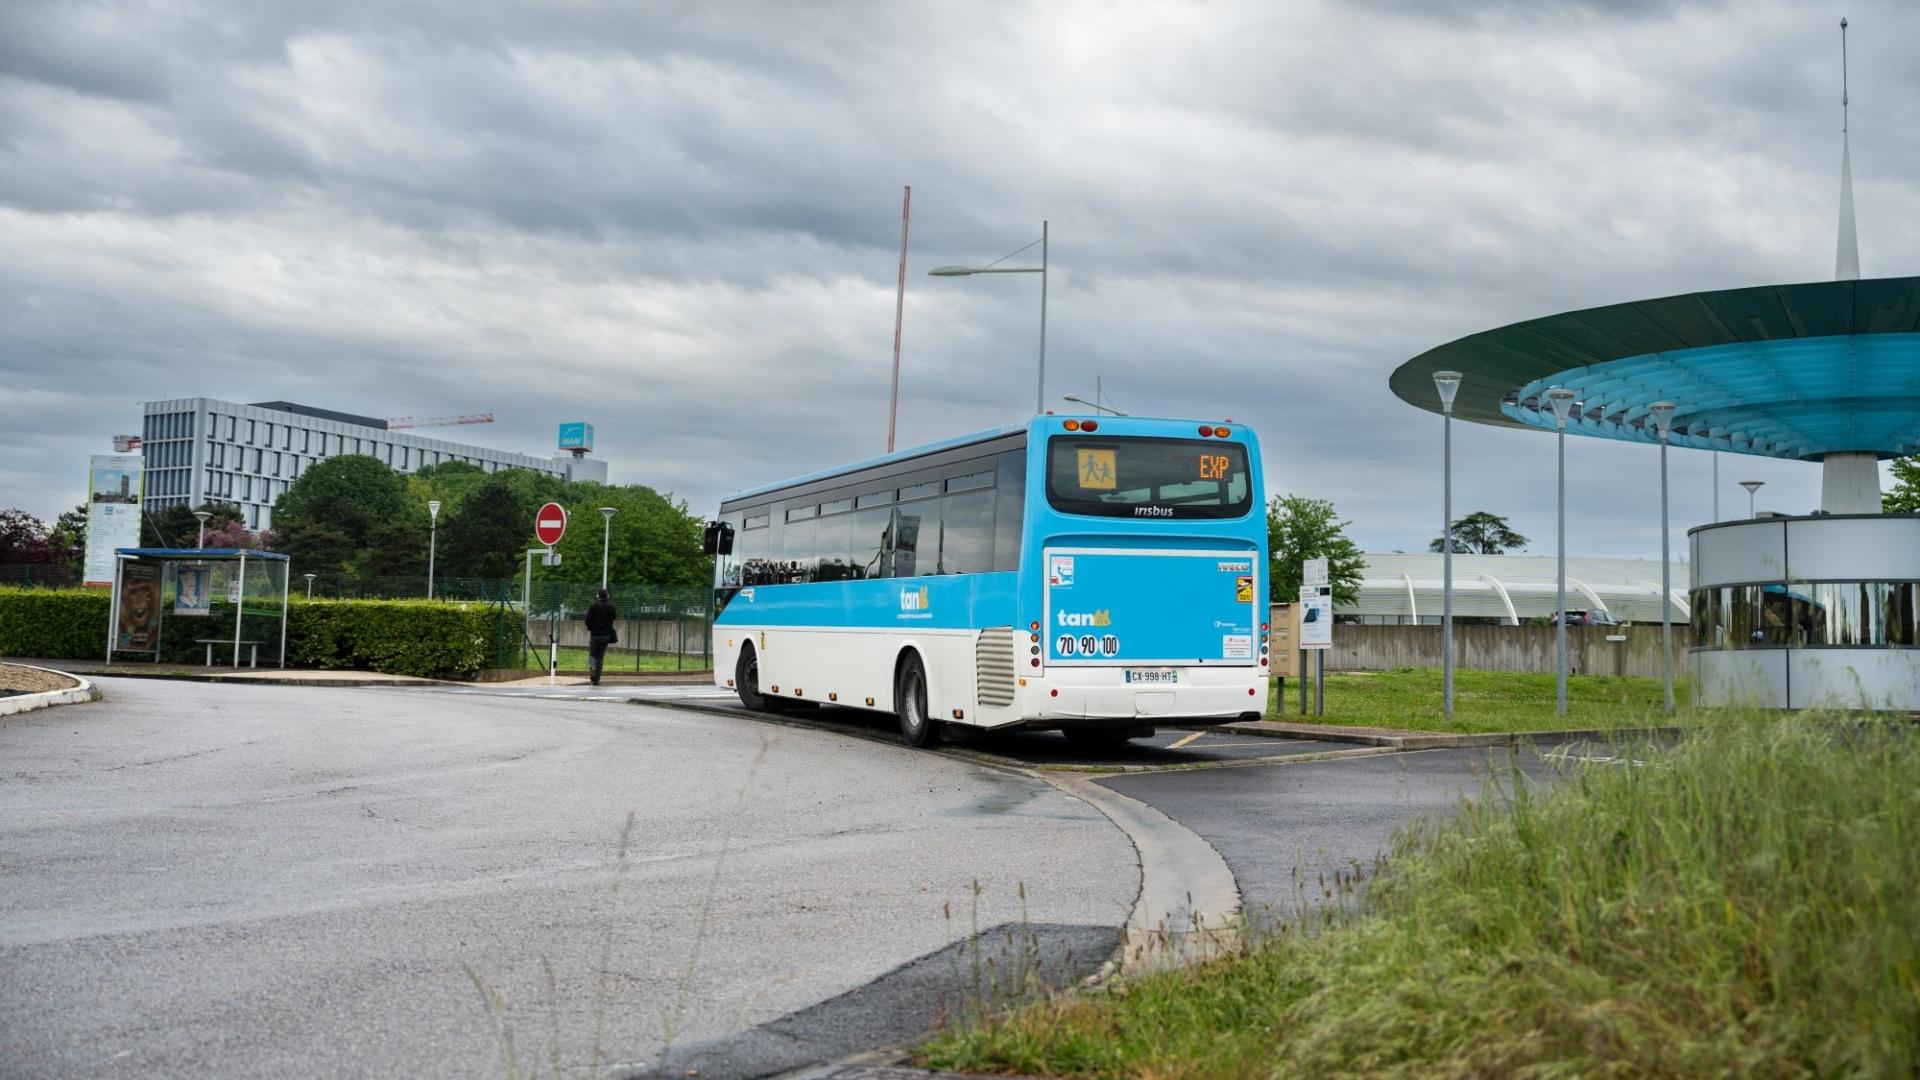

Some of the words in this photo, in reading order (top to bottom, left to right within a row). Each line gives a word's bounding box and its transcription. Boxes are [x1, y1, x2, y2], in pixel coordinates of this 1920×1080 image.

[1200, 454, 1229, 479] EXP
[1134, 505, 1174, 517] irisbus
[1060, 636, 1074, 654] 70
[1081, 636, 1095, 654] 90
[1102, 636, 1117, 654] 100
